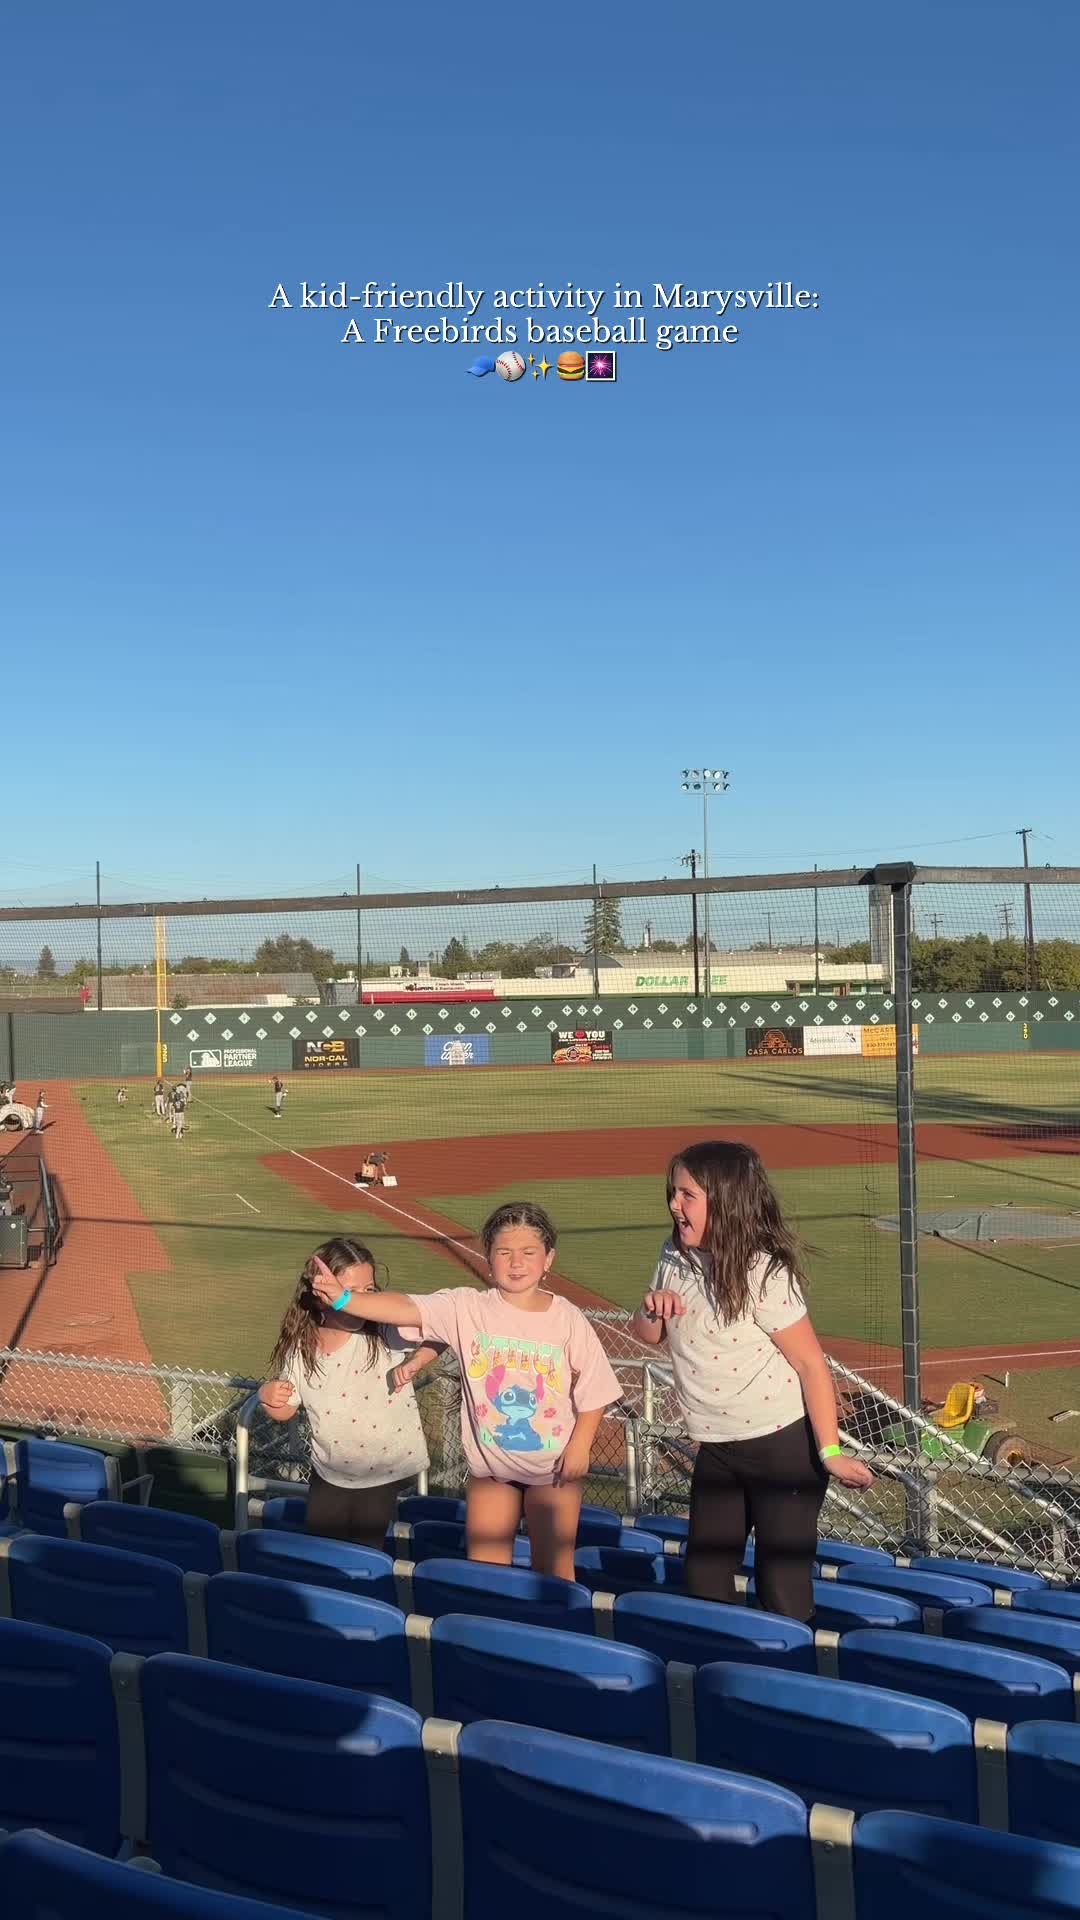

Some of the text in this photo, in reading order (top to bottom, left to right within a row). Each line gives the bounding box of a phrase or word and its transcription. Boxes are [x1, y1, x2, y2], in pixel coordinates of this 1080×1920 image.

[636, 975, 689, 987] DOLLAR
[558, 1030, 606, 1039] WE YOU
[747, 1047, 803, 1056] CASA CARLOS
